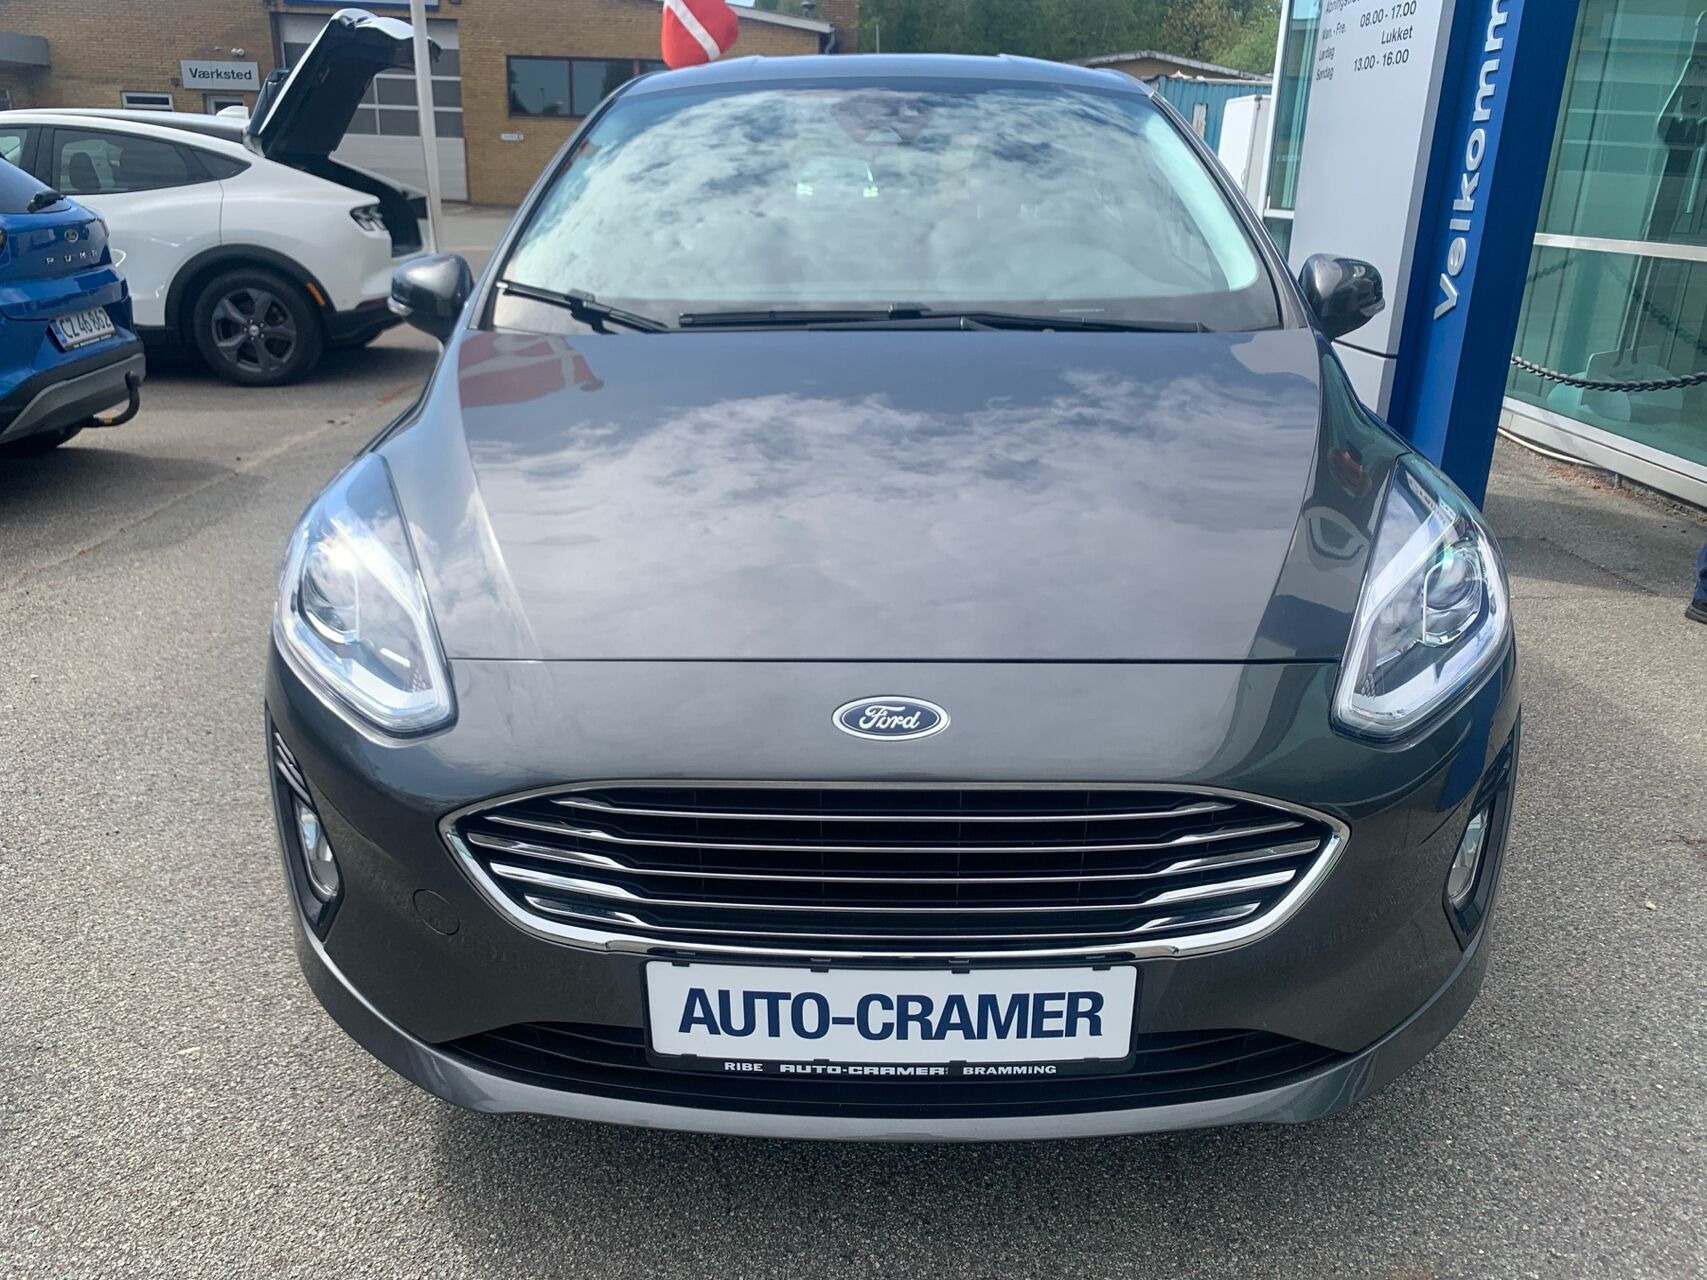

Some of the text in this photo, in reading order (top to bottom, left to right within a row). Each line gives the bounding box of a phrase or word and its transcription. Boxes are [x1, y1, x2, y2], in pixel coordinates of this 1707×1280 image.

[1360, 8, 1384, 28] 08.00
[1391, 0, 1417, 20] 17.00
[1381, 25, 1413, 44] Lukket
[1354, 54, 1376, 72] 13.00
[1382, 48, 1410, 66] 16.00
[188, 67, 252, 80] Værksted
[859, 705, 921, 729] Ford
[678, 987, 1105, 1041] AUTO-CRAMER
[724, 1061, 764, 1072] RIBE
[780, 1063, 945, 1075] AUTO-CRAMER
[963, 1064, 1057, 1075] BRAMMING
